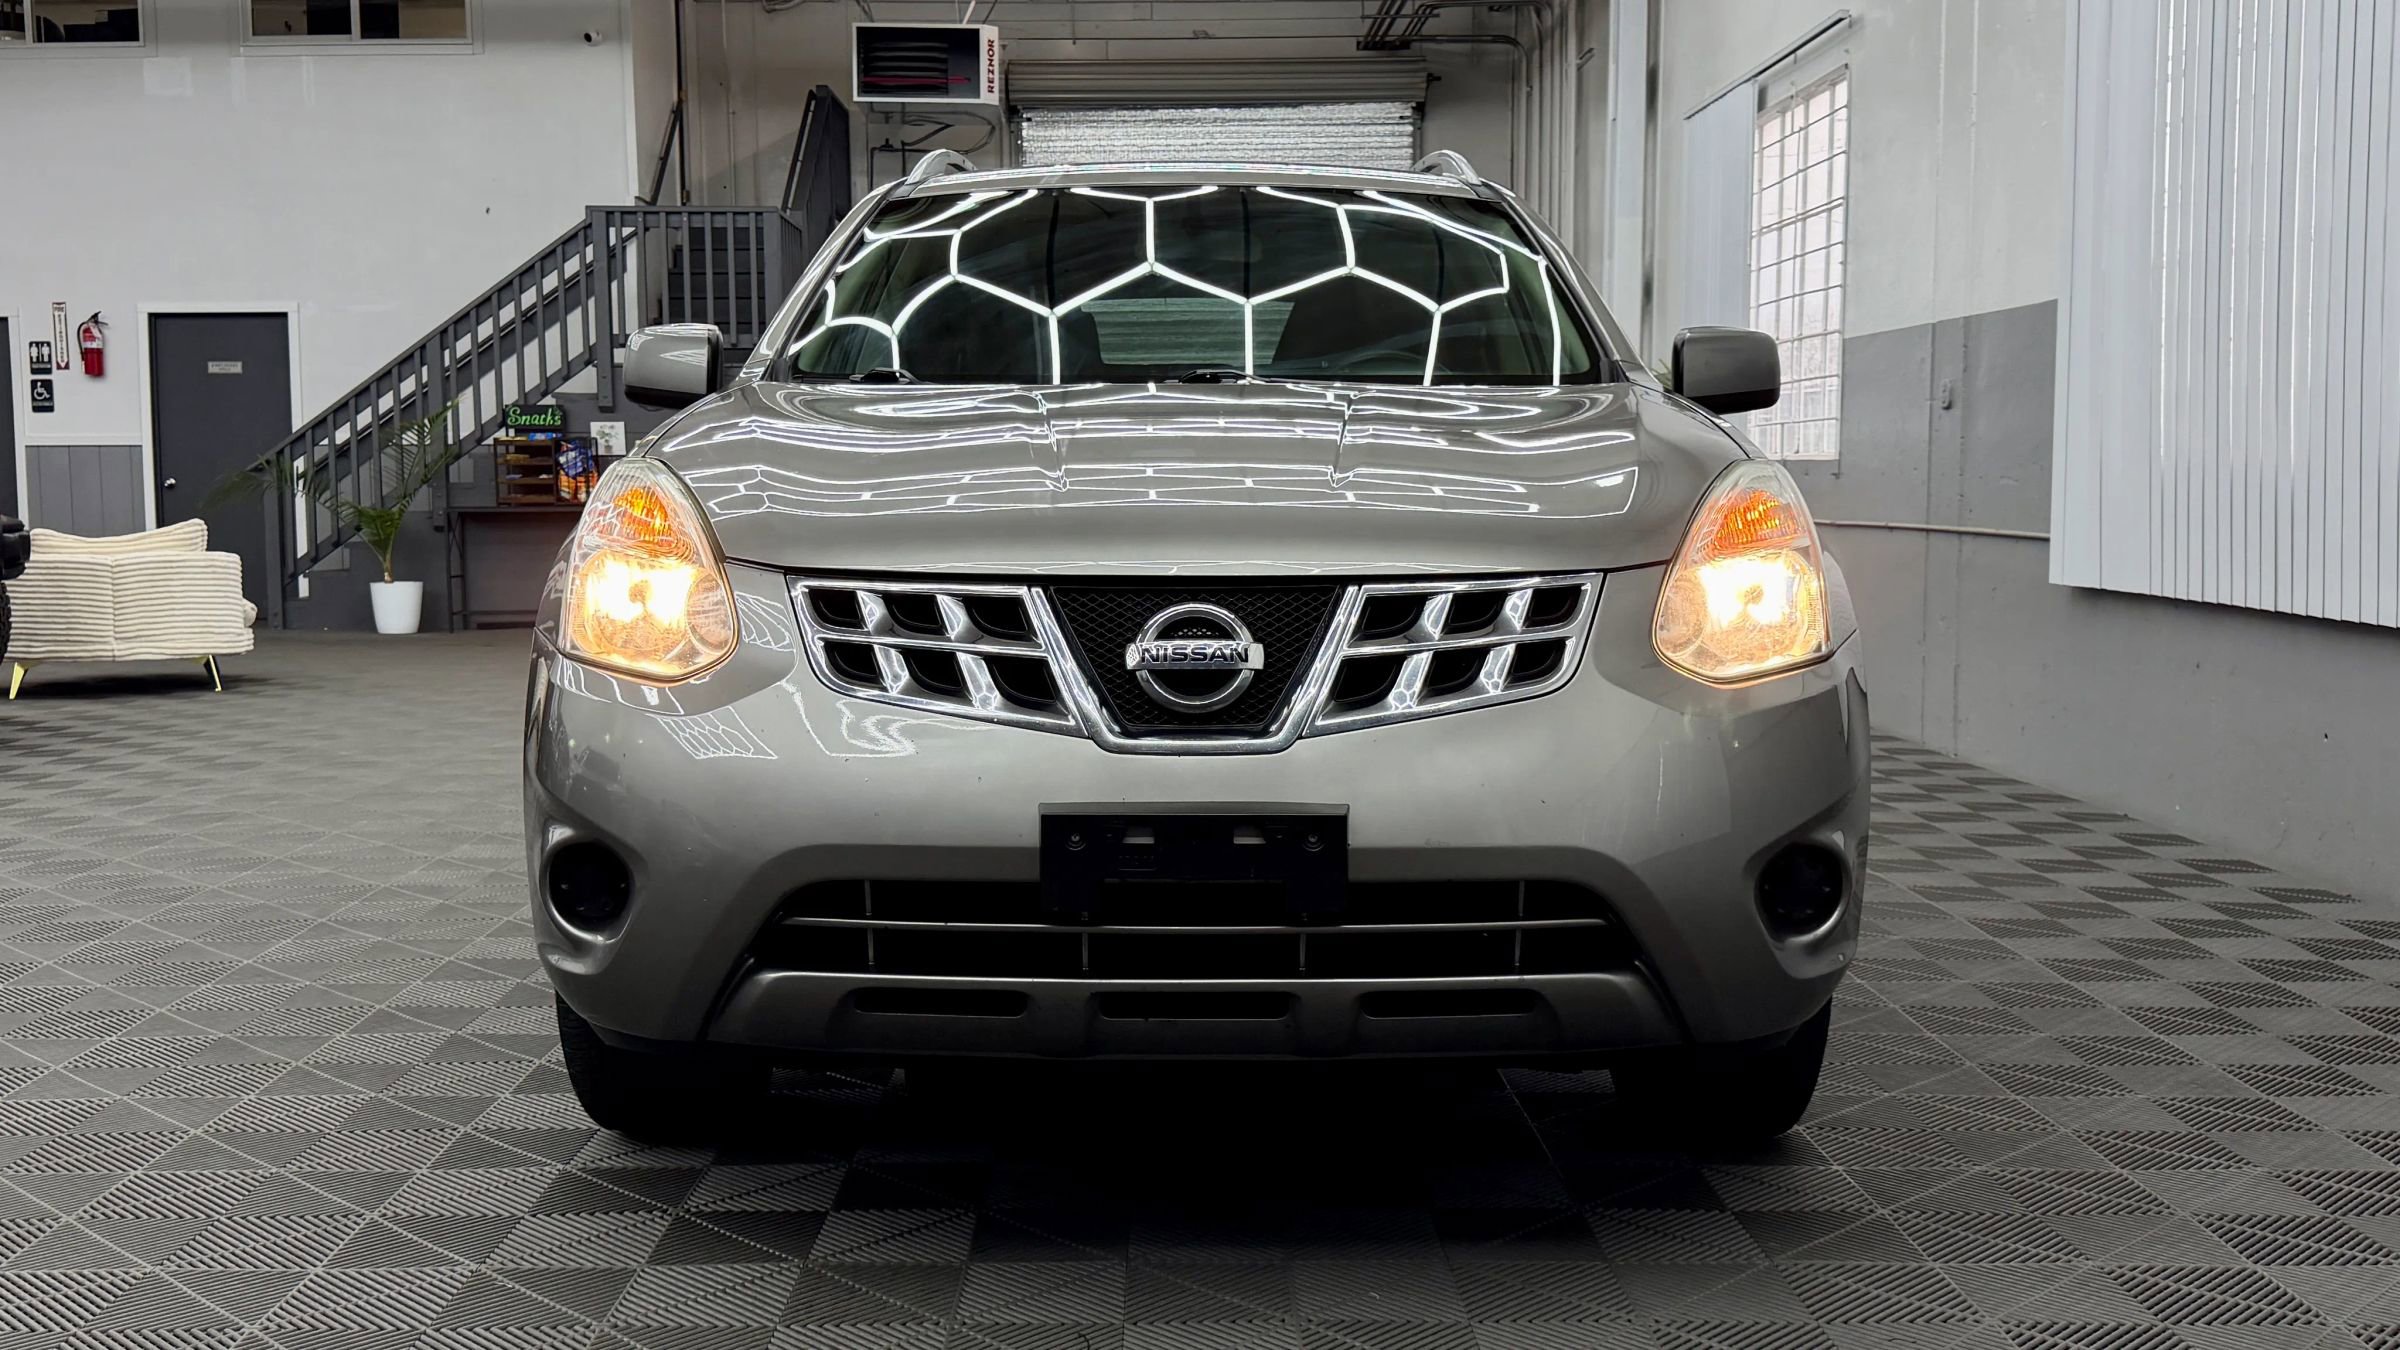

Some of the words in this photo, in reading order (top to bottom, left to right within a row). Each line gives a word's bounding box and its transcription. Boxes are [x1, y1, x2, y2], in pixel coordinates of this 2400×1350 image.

[987, 39, 995, 93] REZNOR
[507, 406, 562, 426] Snacks
[1141, 645, 1249, 664] NISSAN
